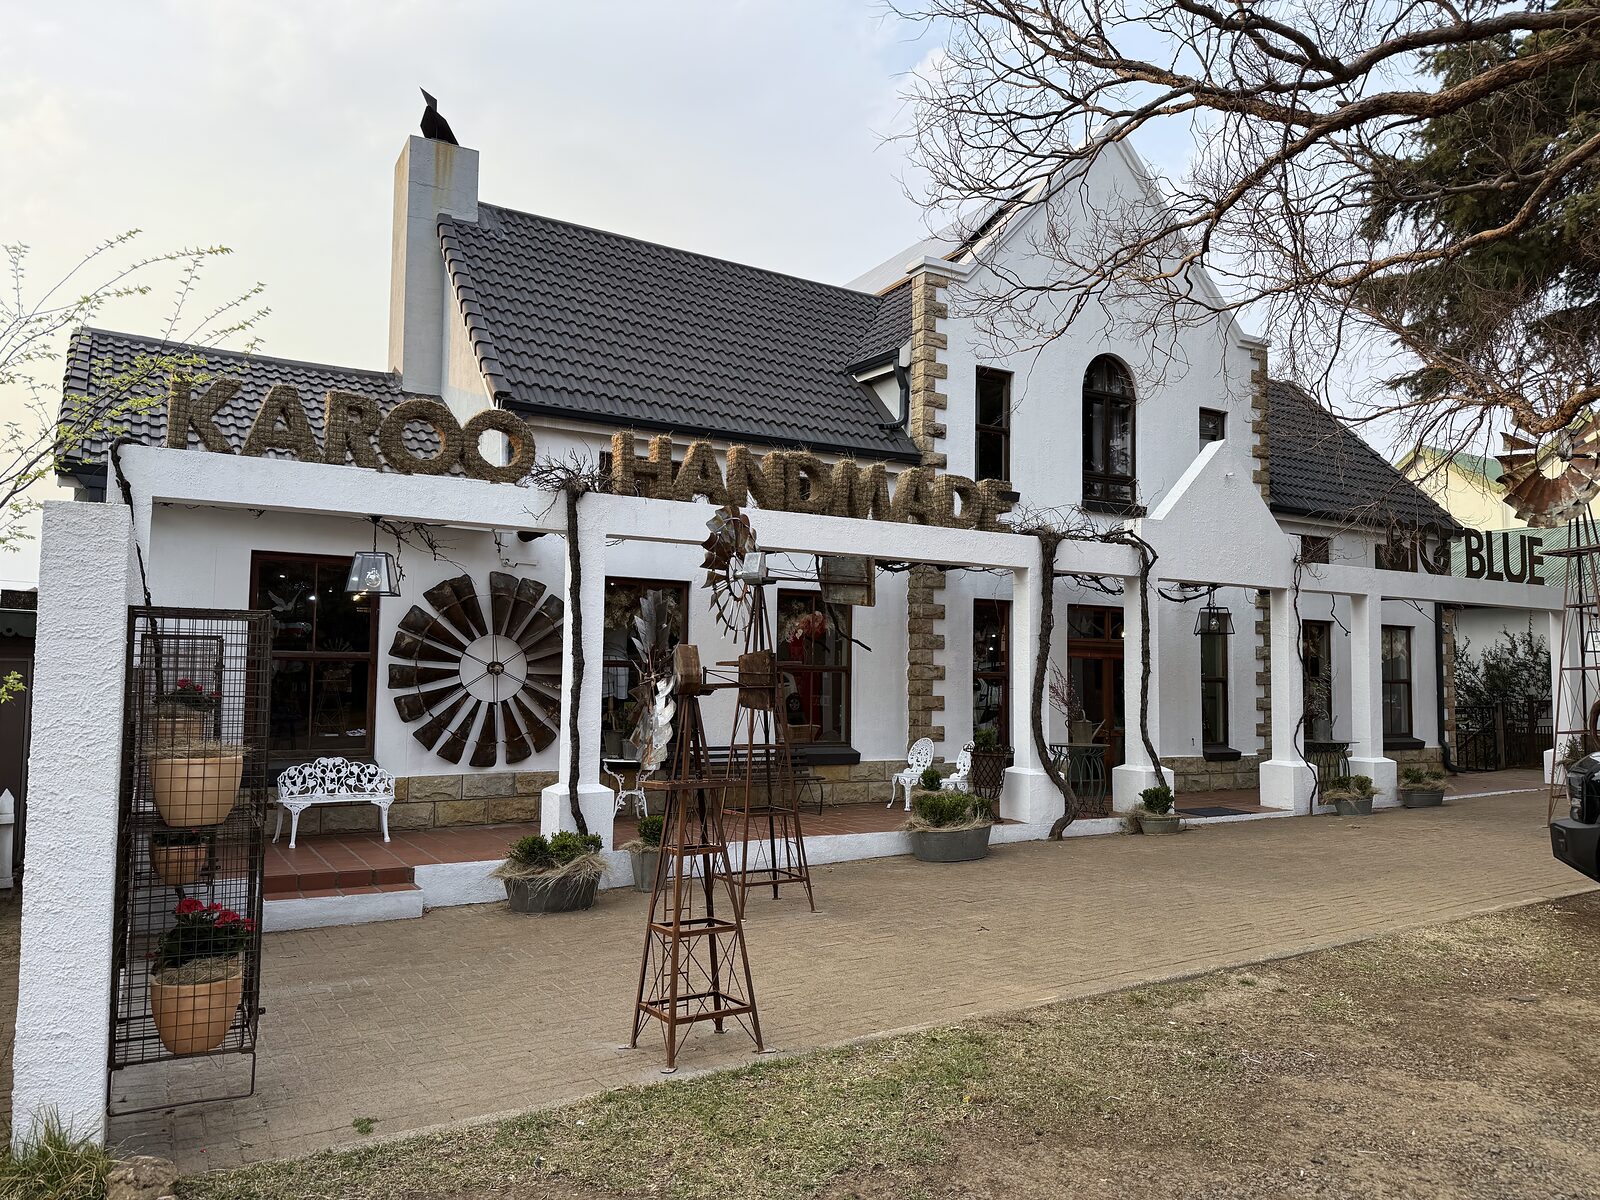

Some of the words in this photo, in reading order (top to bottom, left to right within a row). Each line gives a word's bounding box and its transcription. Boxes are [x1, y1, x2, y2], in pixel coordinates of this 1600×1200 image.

[165, 370, 536, 485] KAROO
[611, 429, 1013, 534] HANDMADE
[1464, 527, 1545, 586] BLUE
